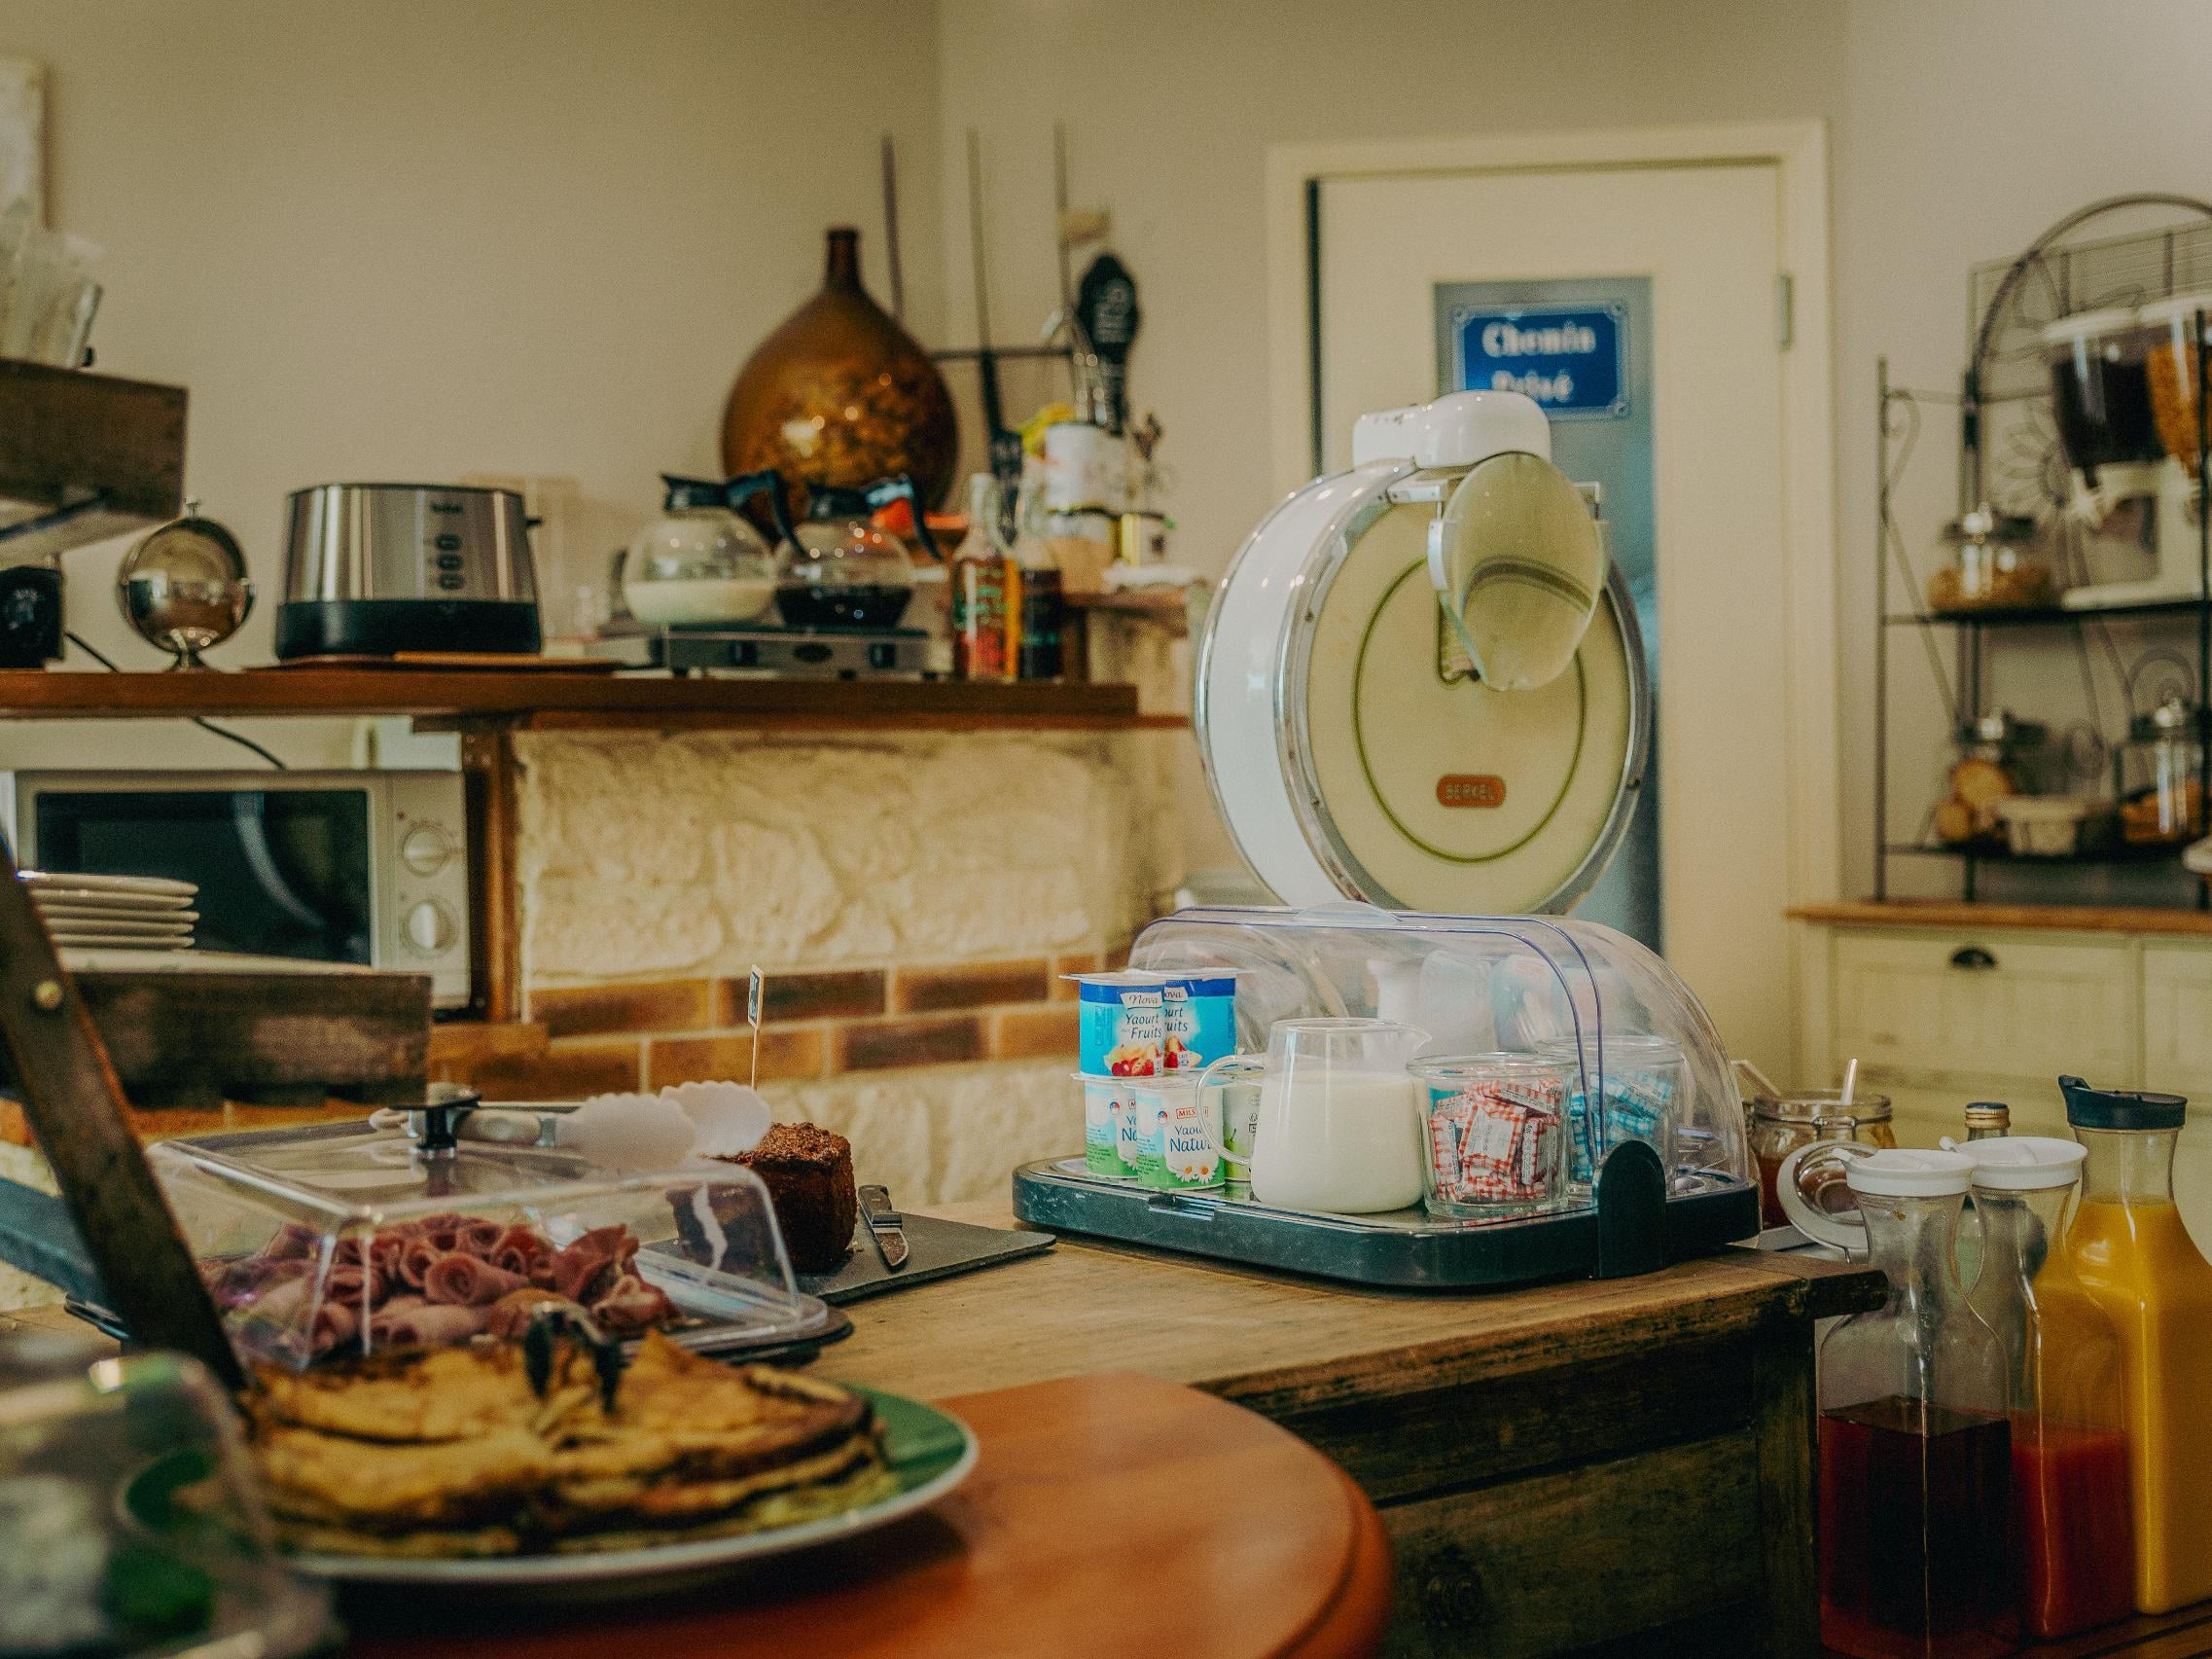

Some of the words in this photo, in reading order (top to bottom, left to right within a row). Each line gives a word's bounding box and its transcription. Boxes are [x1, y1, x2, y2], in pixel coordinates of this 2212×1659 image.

[1481, 320, 1596, 357] Chemin
[1128, 994, 1158, 1004] Nova
[1164, 1007, 1184, 1018] urt
[1125, 1013, 1160, 1025] Yaourt
[1164, 1019, 1189, 1032] uits
[1130, 1026, 1162, 1039] Fruits
